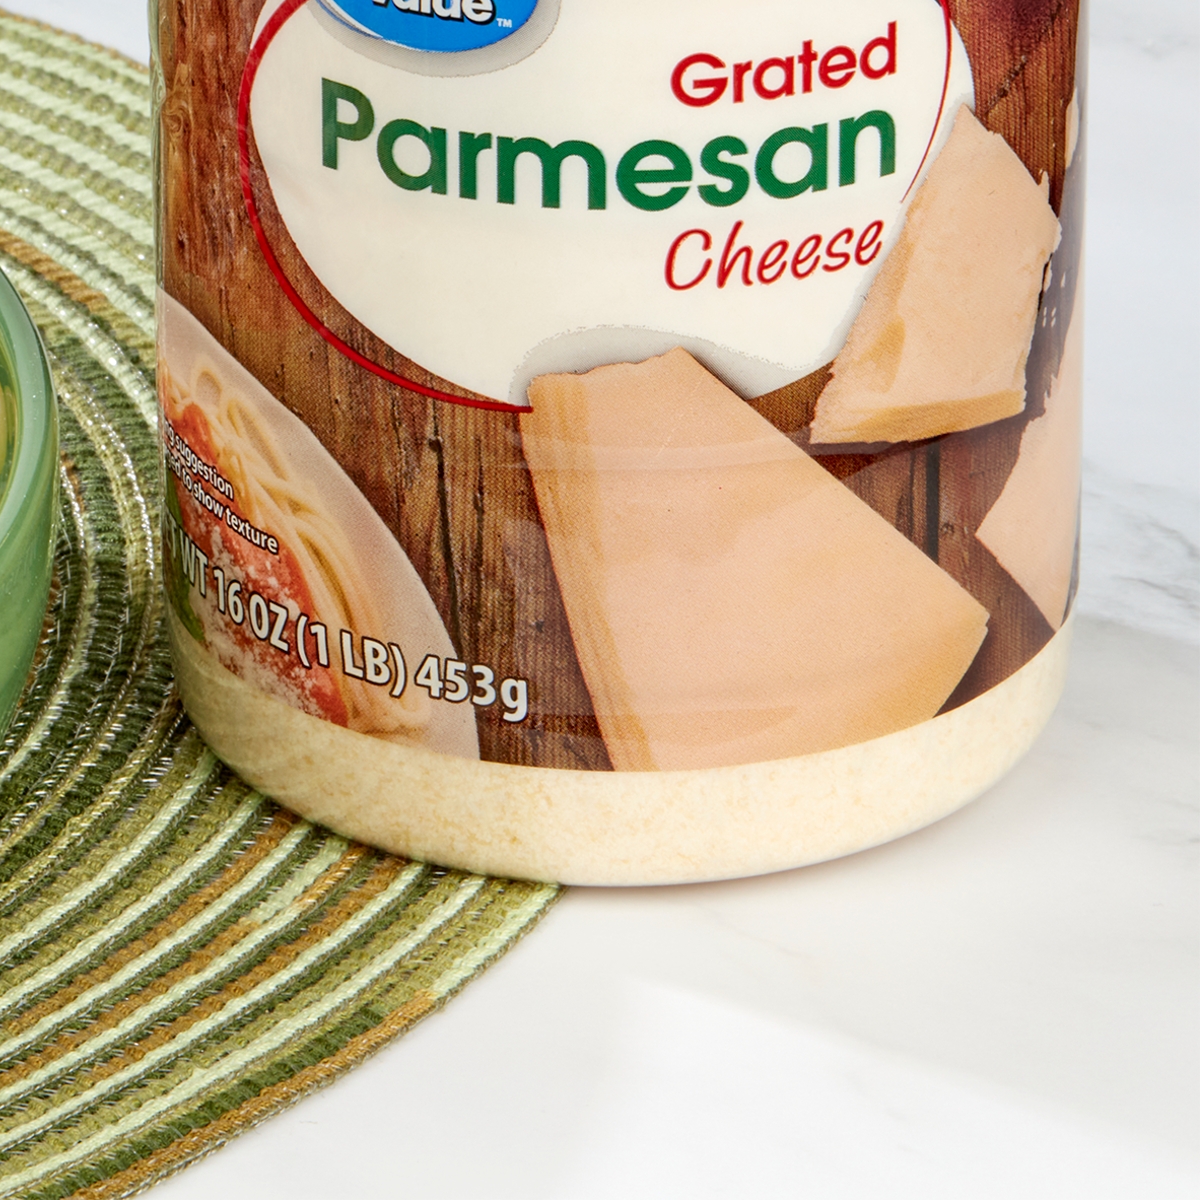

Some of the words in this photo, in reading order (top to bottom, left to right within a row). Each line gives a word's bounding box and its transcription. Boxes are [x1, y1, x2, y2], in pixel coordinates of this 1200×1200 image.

[670, 21, 898, 108] Grated
[320, 76, 897, 212] Parmesan
[664, 219, 885, 291] Cheese
[175, 434, 234, 500] suggestion
[182, 467, 193, 491] to
[193, 481, 224, 519] show
[225, 507, 279, 554] texture
[179, 526, 208, 598] WT
[213, 566, 244, 626] 16
[249, 592, 290, 652] OZ
[295, 615, 330, 668] (1
[340, 630, 407, 697] LB)
[415, 655, 529, 722] 453g
